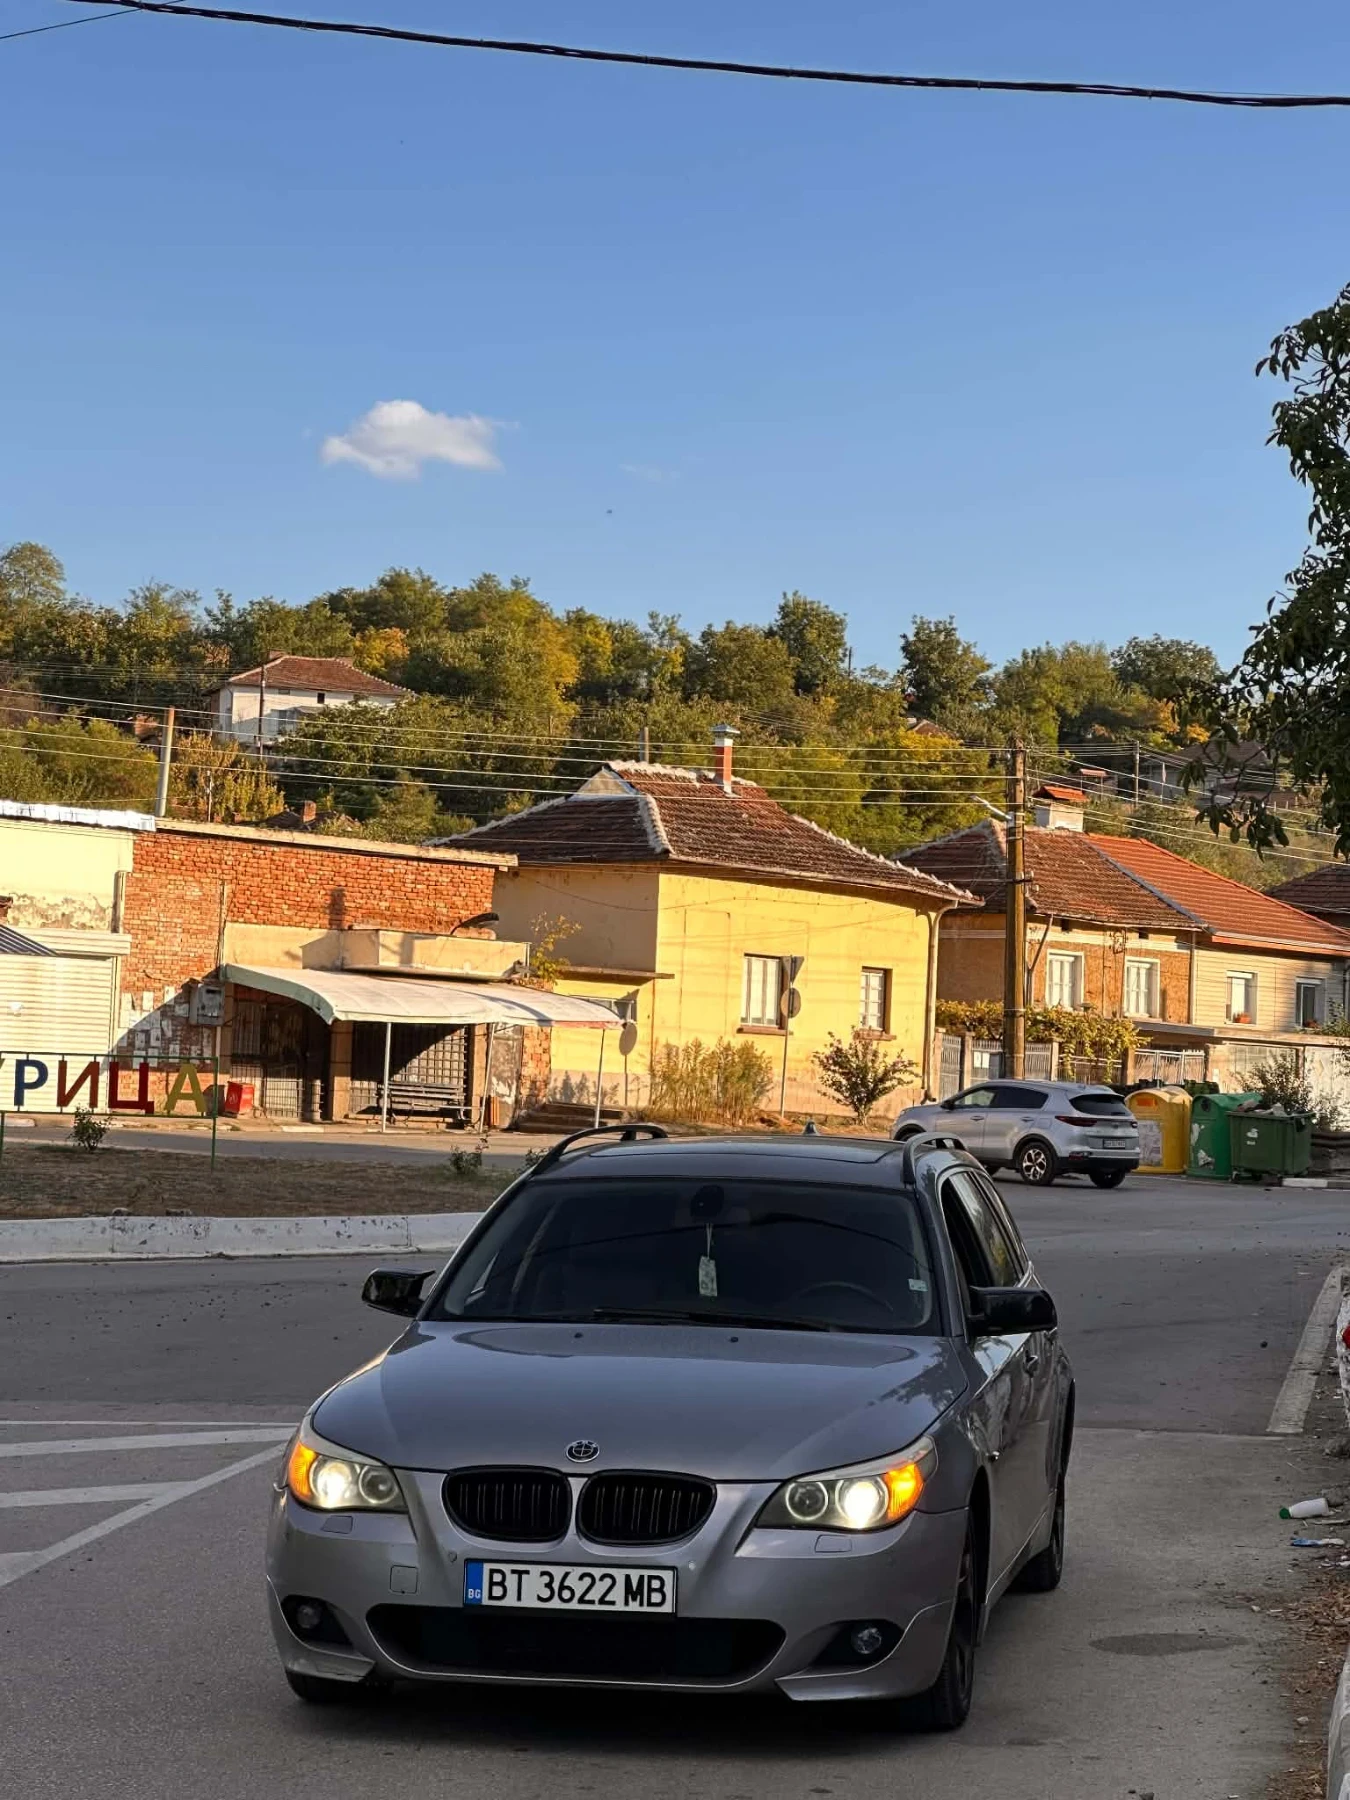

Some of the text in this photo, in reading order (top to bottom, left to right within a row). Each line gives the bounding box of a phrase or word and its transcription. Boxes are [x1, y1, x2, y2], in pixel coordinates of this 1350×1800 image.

[0, 1058, 207, 1113] РИЦА
[468, 1588, 481, 1599] BG
[488, 1568, 667, 1607] BT 3622 MB
